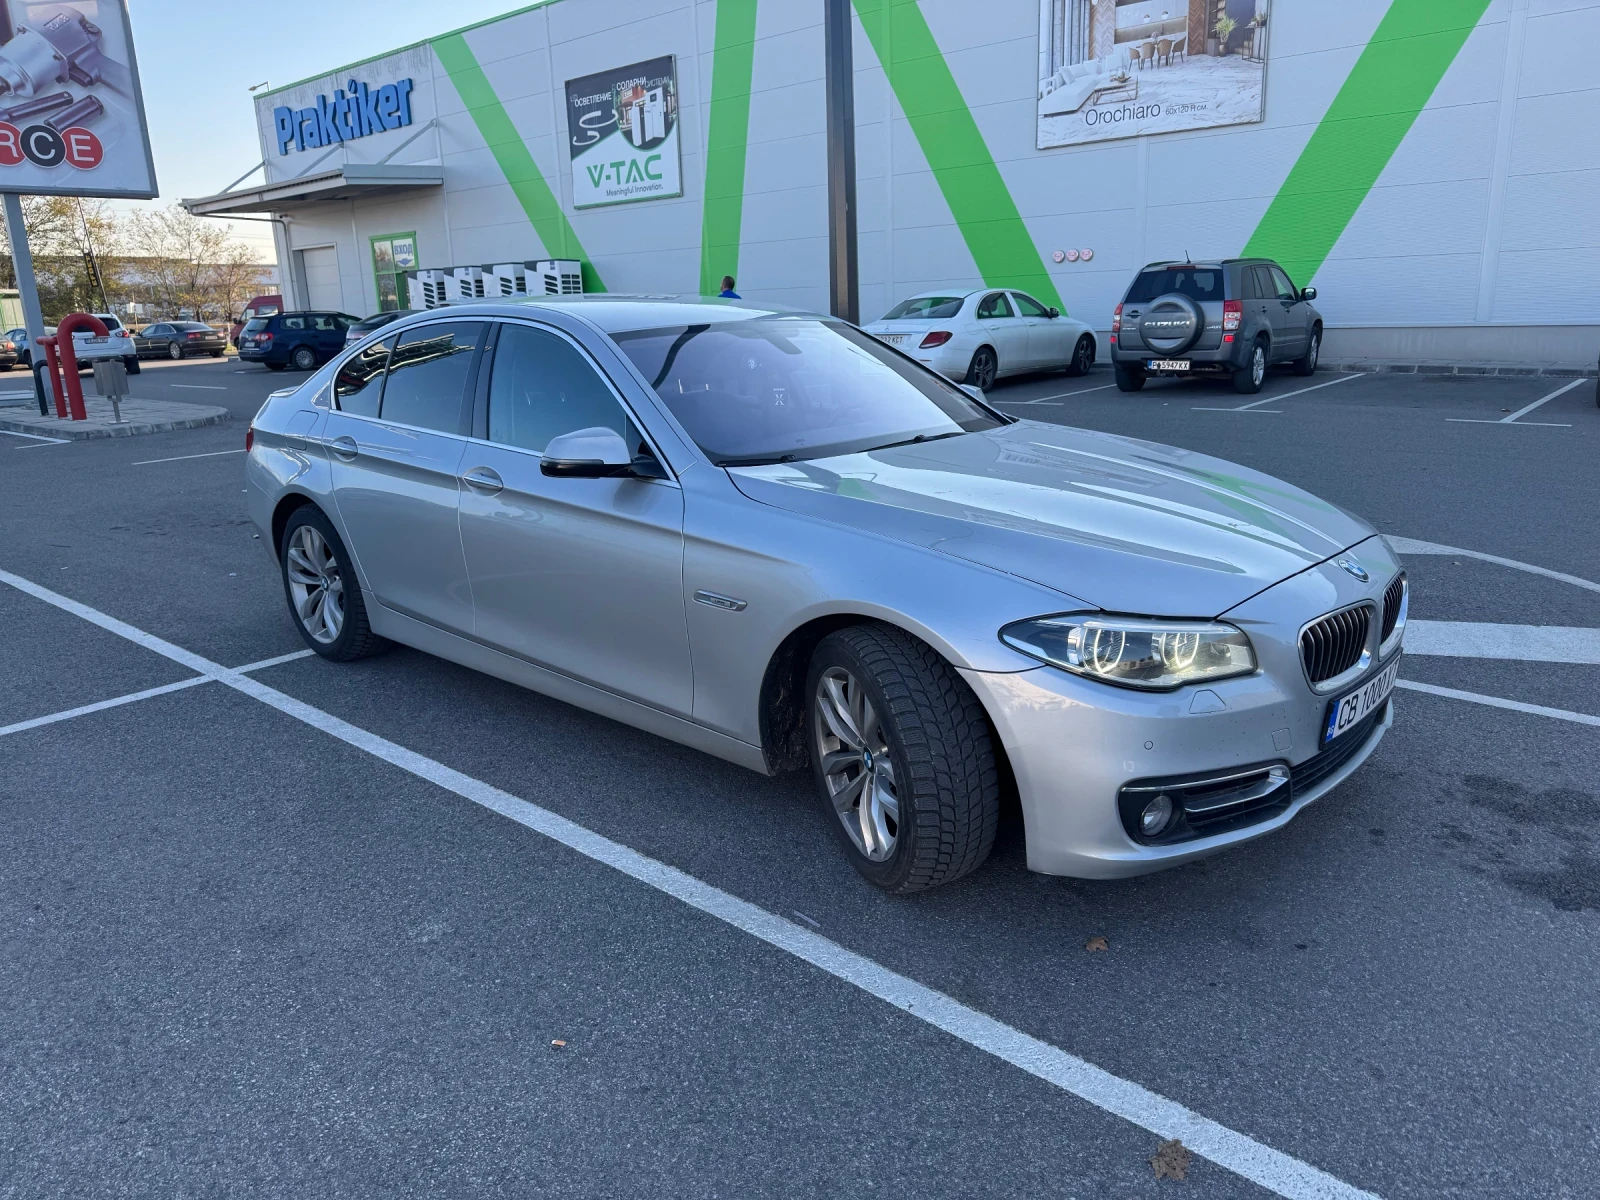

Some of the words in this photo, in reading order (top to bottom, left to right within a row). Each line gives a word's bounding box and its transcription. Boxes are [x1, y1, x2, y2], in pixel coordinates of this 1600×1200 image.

[574, 91, 612, 107] ОСВЕТЛЕНИЕ
[273, 78, 413, 156] Praktiker
[1085, 103, 1161, 126] Orochiaro
[606, 185, 635, 197] Meaningful
[394, 243, 413, 256] ВХОД
[1144, 320, 1190, 329] SUZUKI
[1337, 693, 1359, 731] CB
[1360, 671, 1387, 715] 1000
